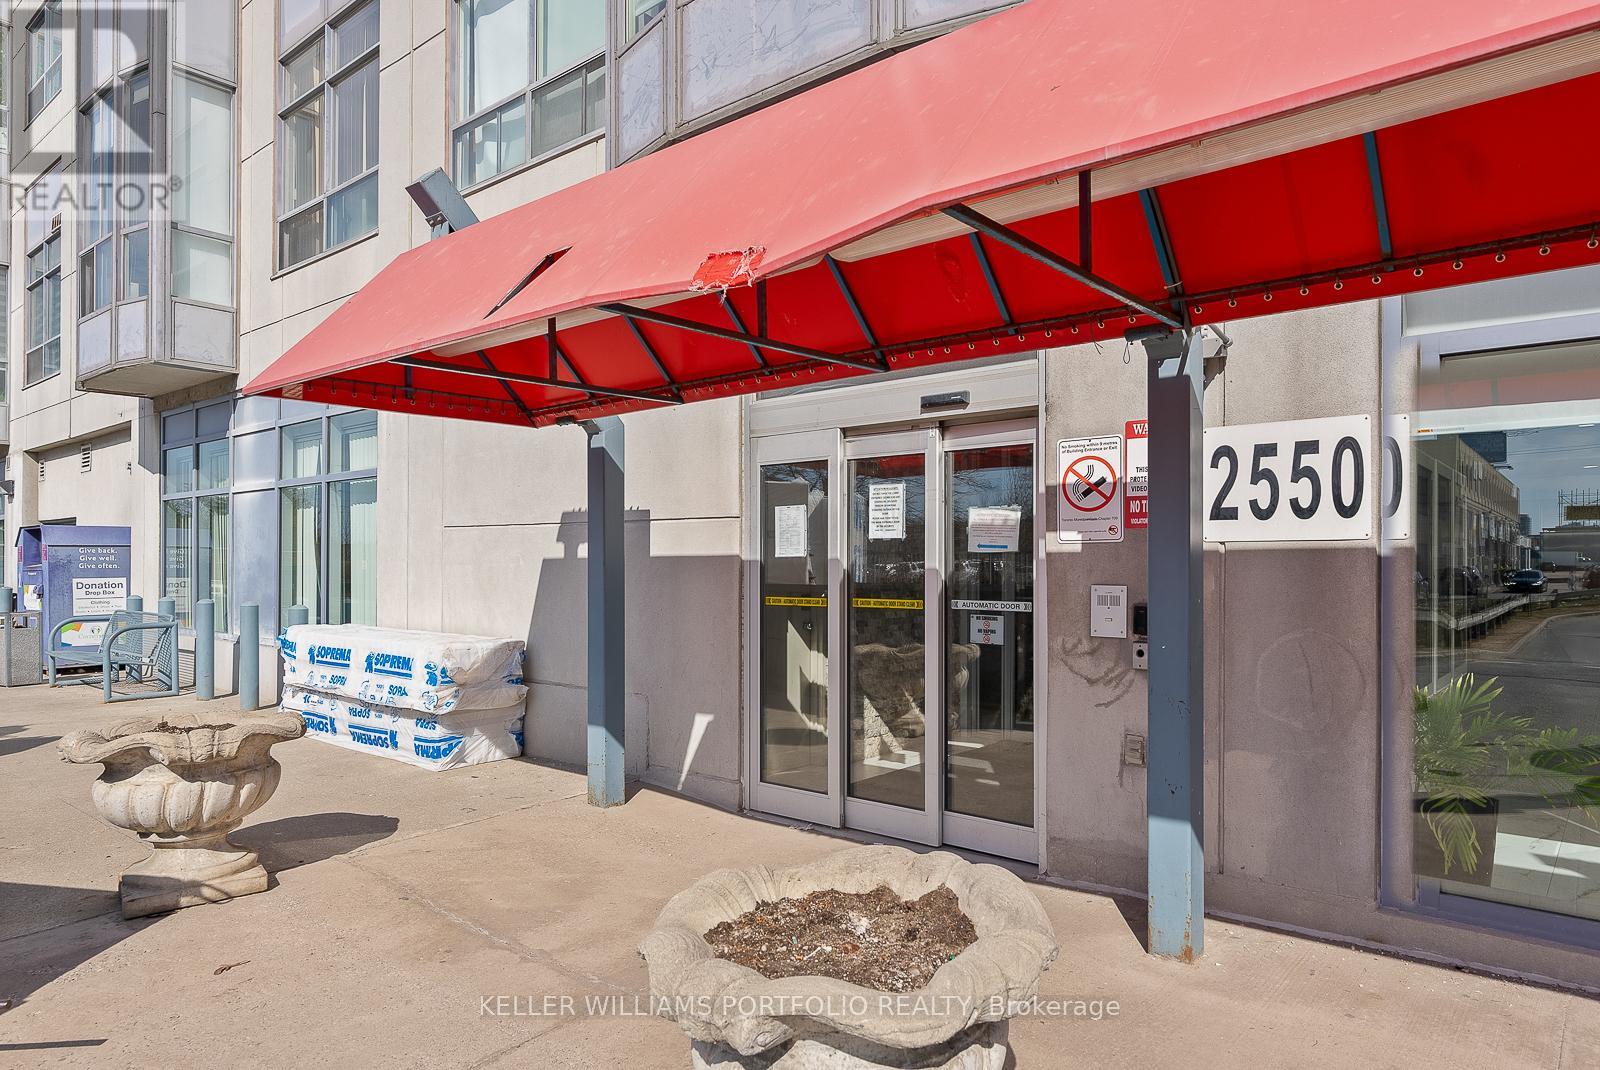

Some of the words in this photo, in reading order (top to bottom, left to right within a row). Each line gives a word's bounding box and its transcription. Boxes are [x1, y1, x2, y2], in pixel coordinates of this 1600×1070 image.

[1209, 435, 1364, 521] 2550
[1130, 500, 1140, 513] NO
[76, 581, 123, 590] Donation
[316, 645, 351, 662] SOPREMA
[304, 716, 329, 734] SOPRE
[349, 730, 390, 749] SOPREMA
